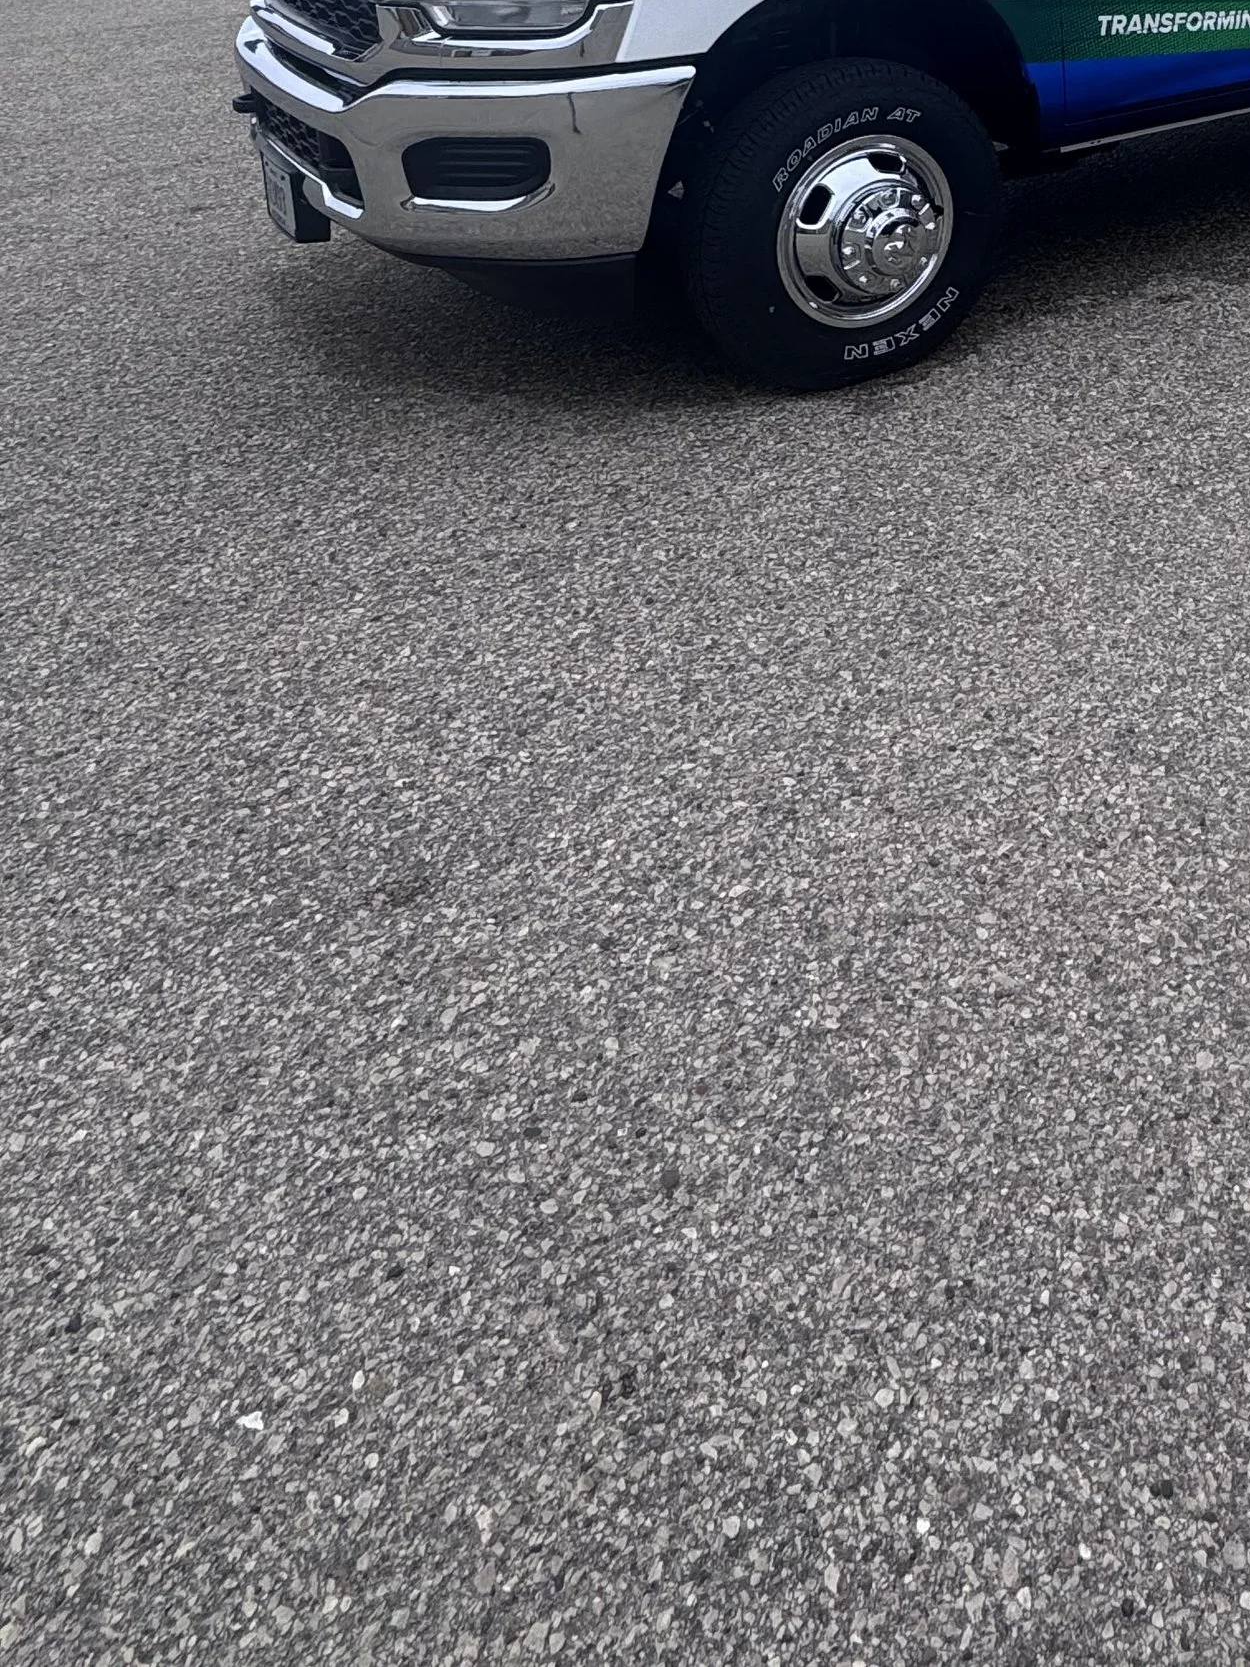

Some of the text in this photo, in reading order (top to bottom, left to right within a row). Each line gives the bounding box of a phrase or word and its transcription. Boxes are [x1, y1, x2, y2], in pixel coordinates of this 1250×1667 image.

[772, 107, 922, 192] ROADIAN AT
[843, 287, 960, 360] NEXEN
